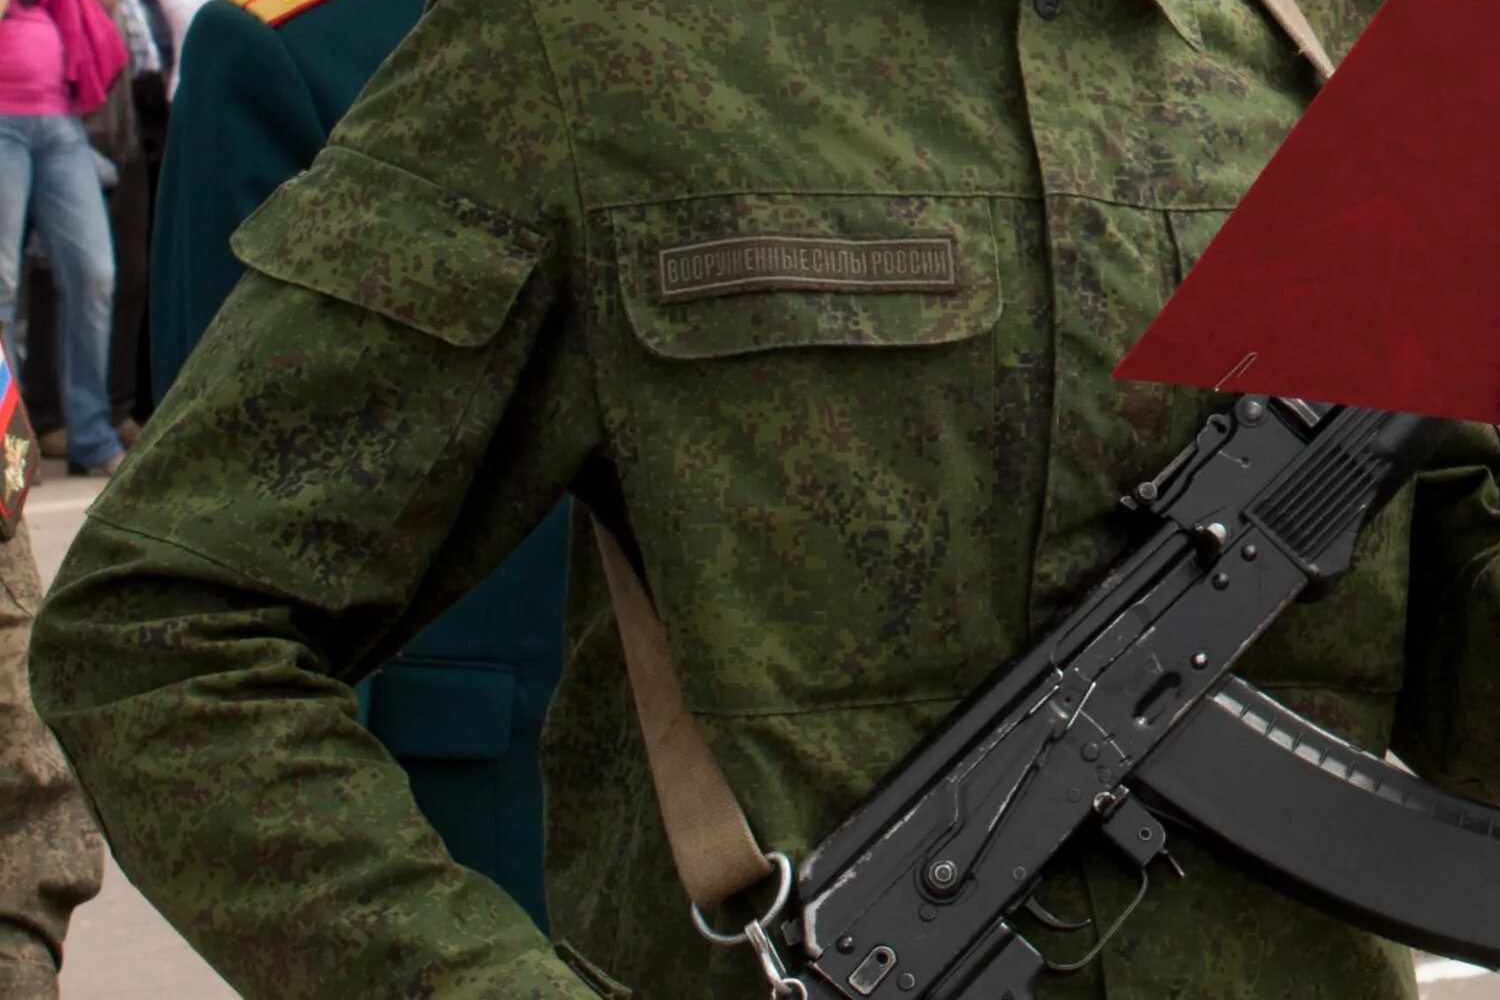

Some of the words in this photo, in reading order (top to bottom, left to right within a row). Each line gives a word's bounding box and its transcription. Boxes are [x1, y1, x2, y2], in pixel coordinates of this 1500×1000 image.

[667, 246, 810, 283] ВООРУЖЕННЫЕ
[812, 248, 868, 276] СИЛЫ
[870, 249, 948, 276] РОССИИ
